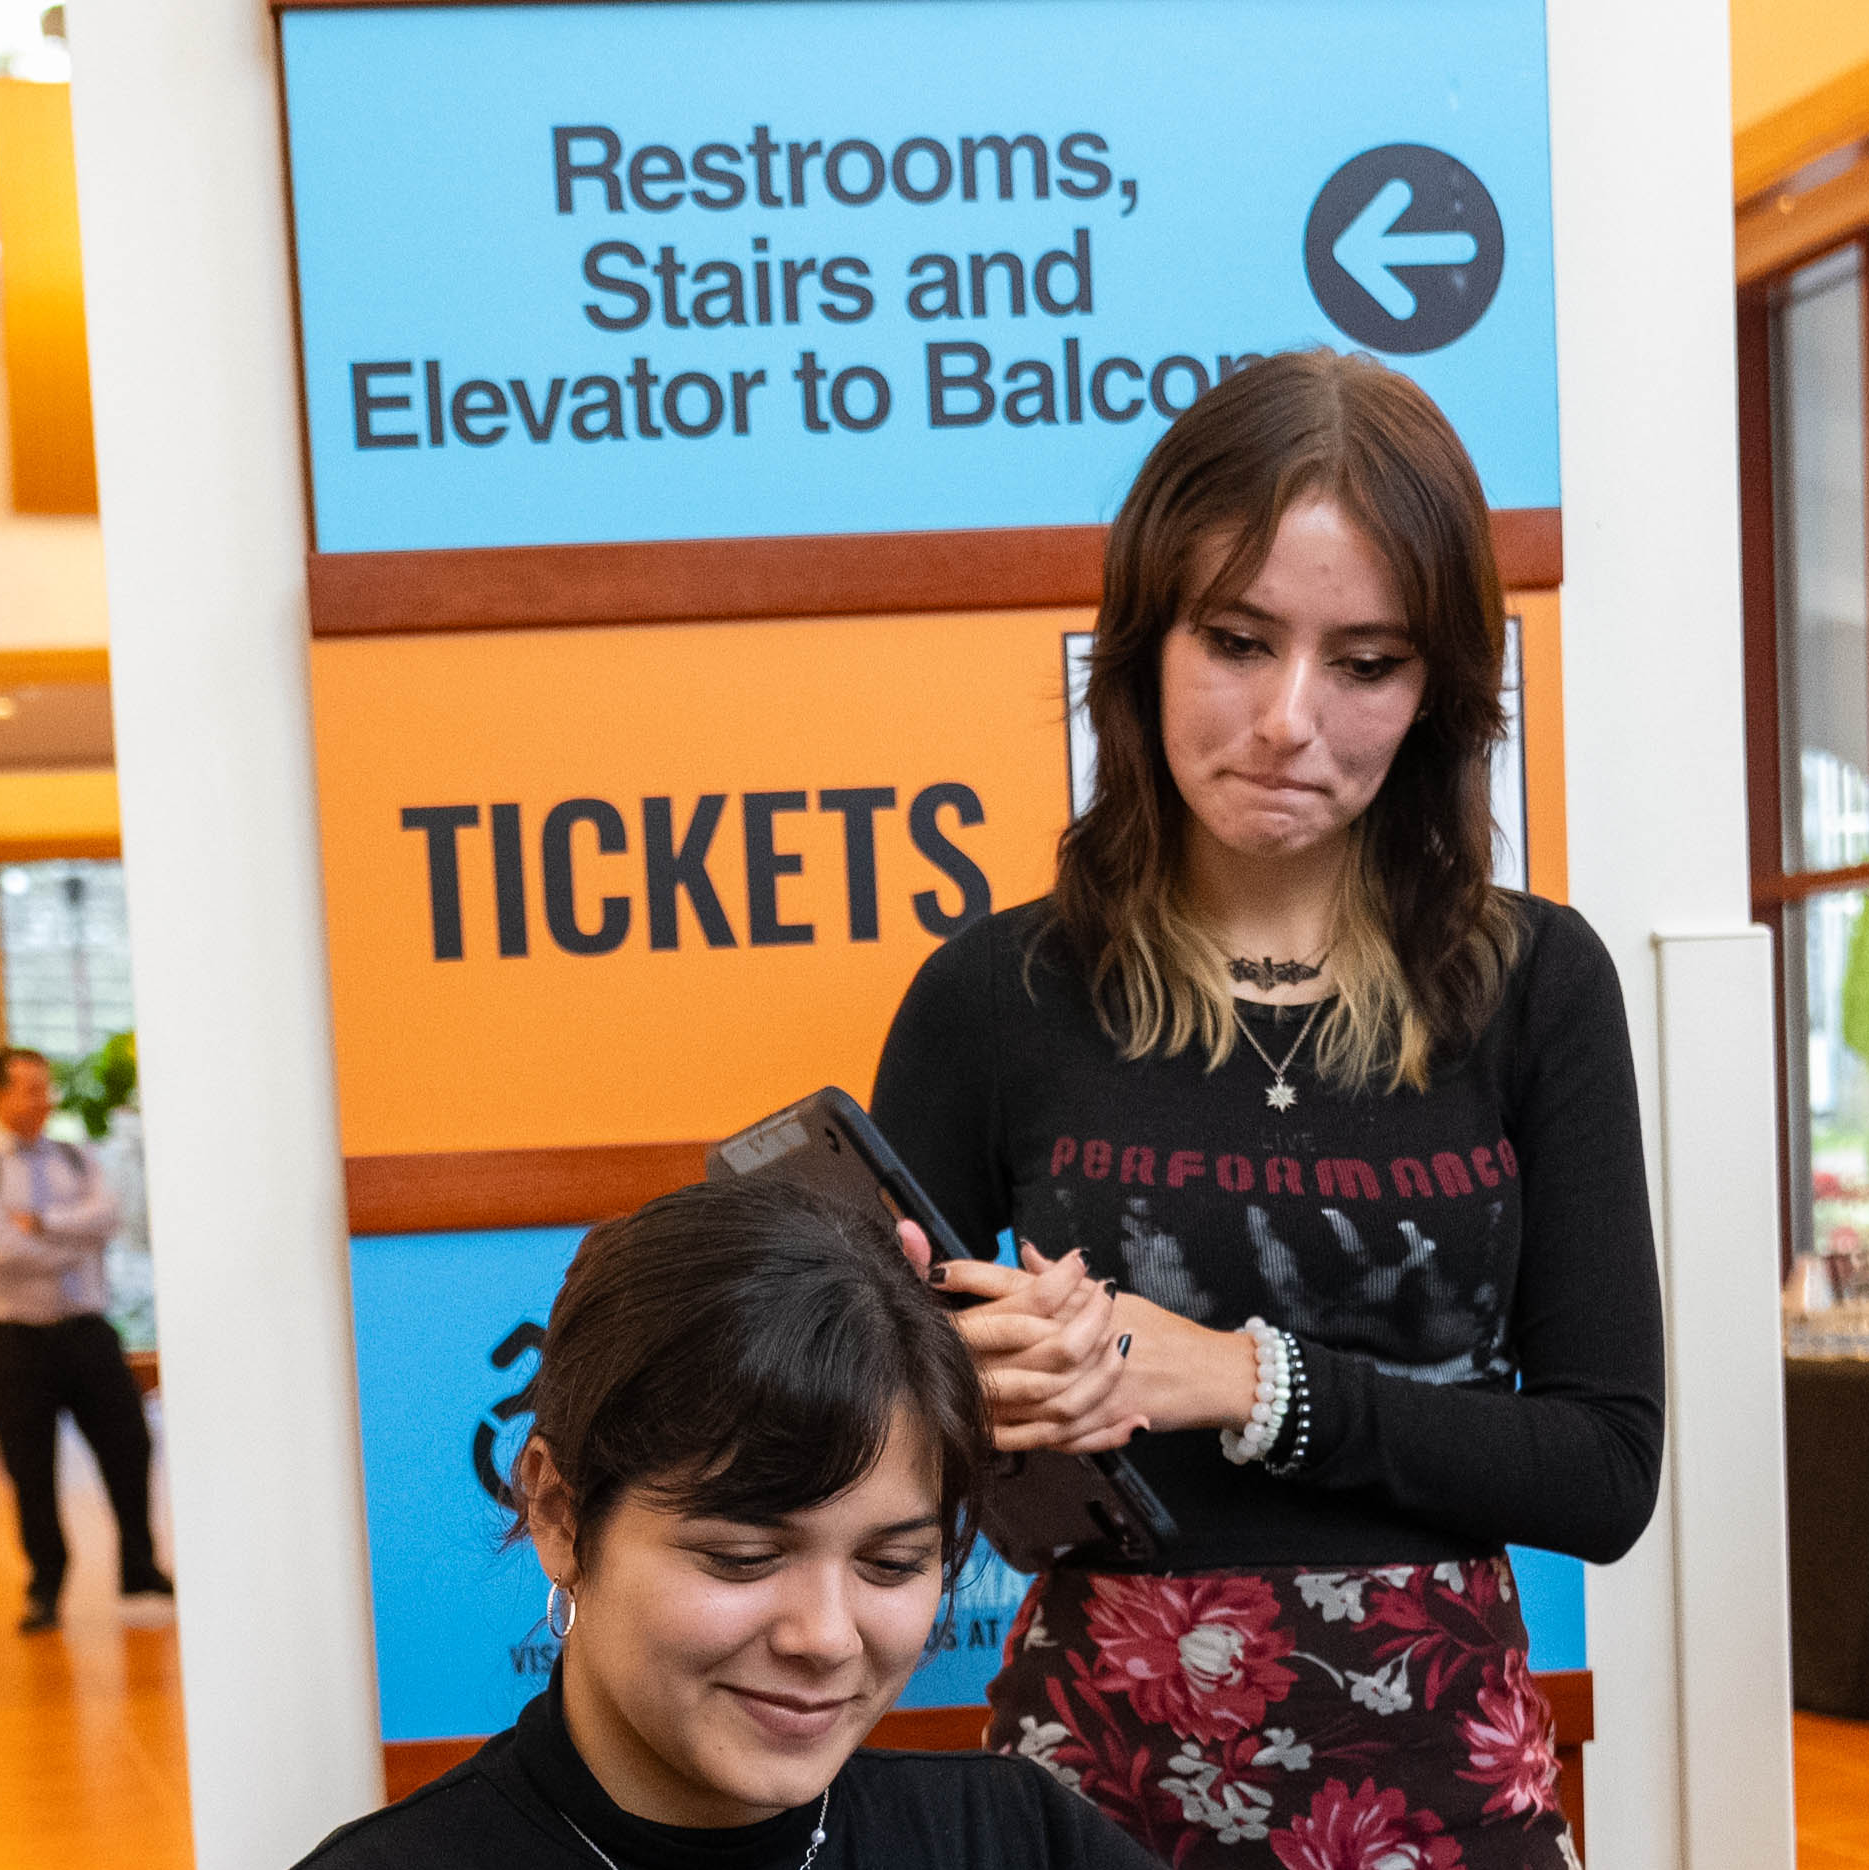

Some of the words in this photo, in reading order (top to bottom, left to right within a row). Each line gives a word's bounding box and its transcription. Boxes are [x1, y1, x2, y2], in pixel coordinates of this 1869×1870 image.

[551, 124, 1140, 217] Restrooms,
[582, 235, 876, 334] Stairs
[905, 226, 1095, 322] and
[349, 355, 768, 452] Elevator
[792, 350, 893, 435] to
[925, 336, 1266, 429] Balco
[400, 780, 992, 962] TICKETS
